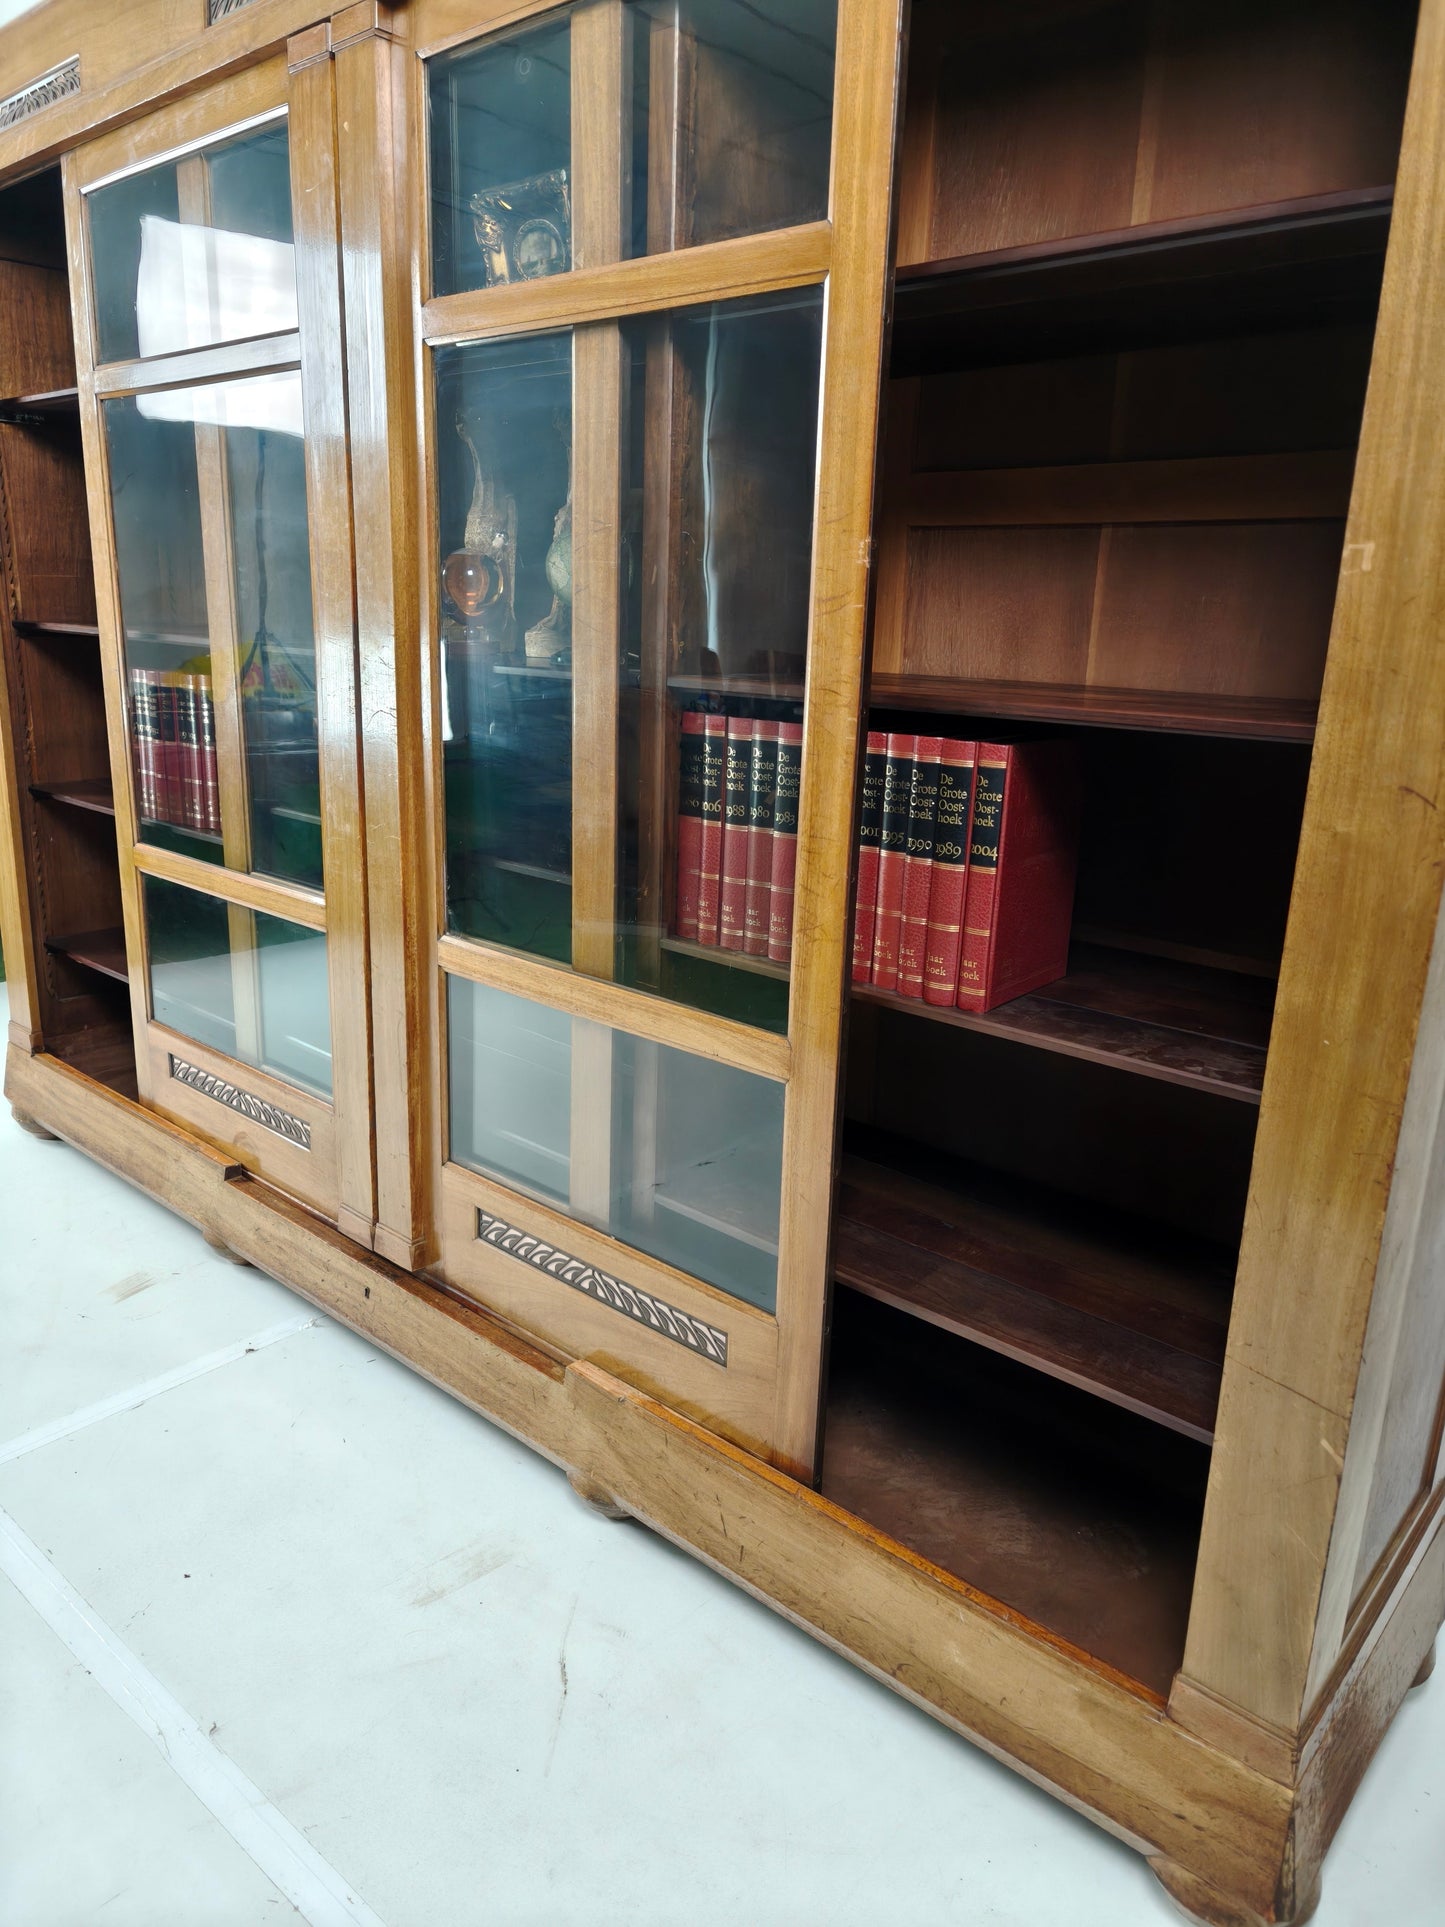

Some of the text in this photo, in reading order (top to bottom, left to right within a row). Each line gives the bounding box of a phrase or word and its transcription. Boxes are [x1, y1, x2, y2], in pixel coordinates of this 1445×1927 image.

[727, 746, 736, 756] De
[753, 747, 762, 757] De
[778, 751, 789, 762] De
[703, 754, 722, 765] Grote
[727, 757, 747, 768] Grote
[753, 759, 774, 769] Grote
[703, 765, 720, 776] Oost-
[727, 768, 746, 779] Oost-
[778, 763, 800, 774] Grote
[886, 764, 897, 775] De
[912, 769, 924, 780] De
[752, 770, 772, 780] Oost-
[777, 775, 800, 785] Oost-
[941, 773, 953, 785] De
[977, 775, 988, 787] De
[703, 777, 717, 787] oek
[752, 781, 771, 792] hoek
[864, 777, 884, 786] rote
[885, 777, 911, 789] Grote
[777, 786, 798, 797] hoek
[911, 782, 937, 794] Grote
[940, 786, 968, 799] Grote
[884, 789, 908, 801] Oost-
[910, 794, 935, 807] Oost-
[976, 788, 1002, 802] Grote
[702, 799, 722, 813] 006
[726, 804, 745, 817] 1988
[883, 801, 906, 814] hoek
[938, 800, 965, 812] Oost-
[974, 801, 999, 815] Oost-
[750, 806, 769, 819] 1980
[775, 811, 795, 825] 1983
[909, 806, 932, 820] hoek
[937, 811, 962, 825] hoek
[861, 826, 880, 837] 001
[882, 830, 904, 844] 1995
[907, 838, 932, 851] 1990
[935, 842, 962, 859] 1989
